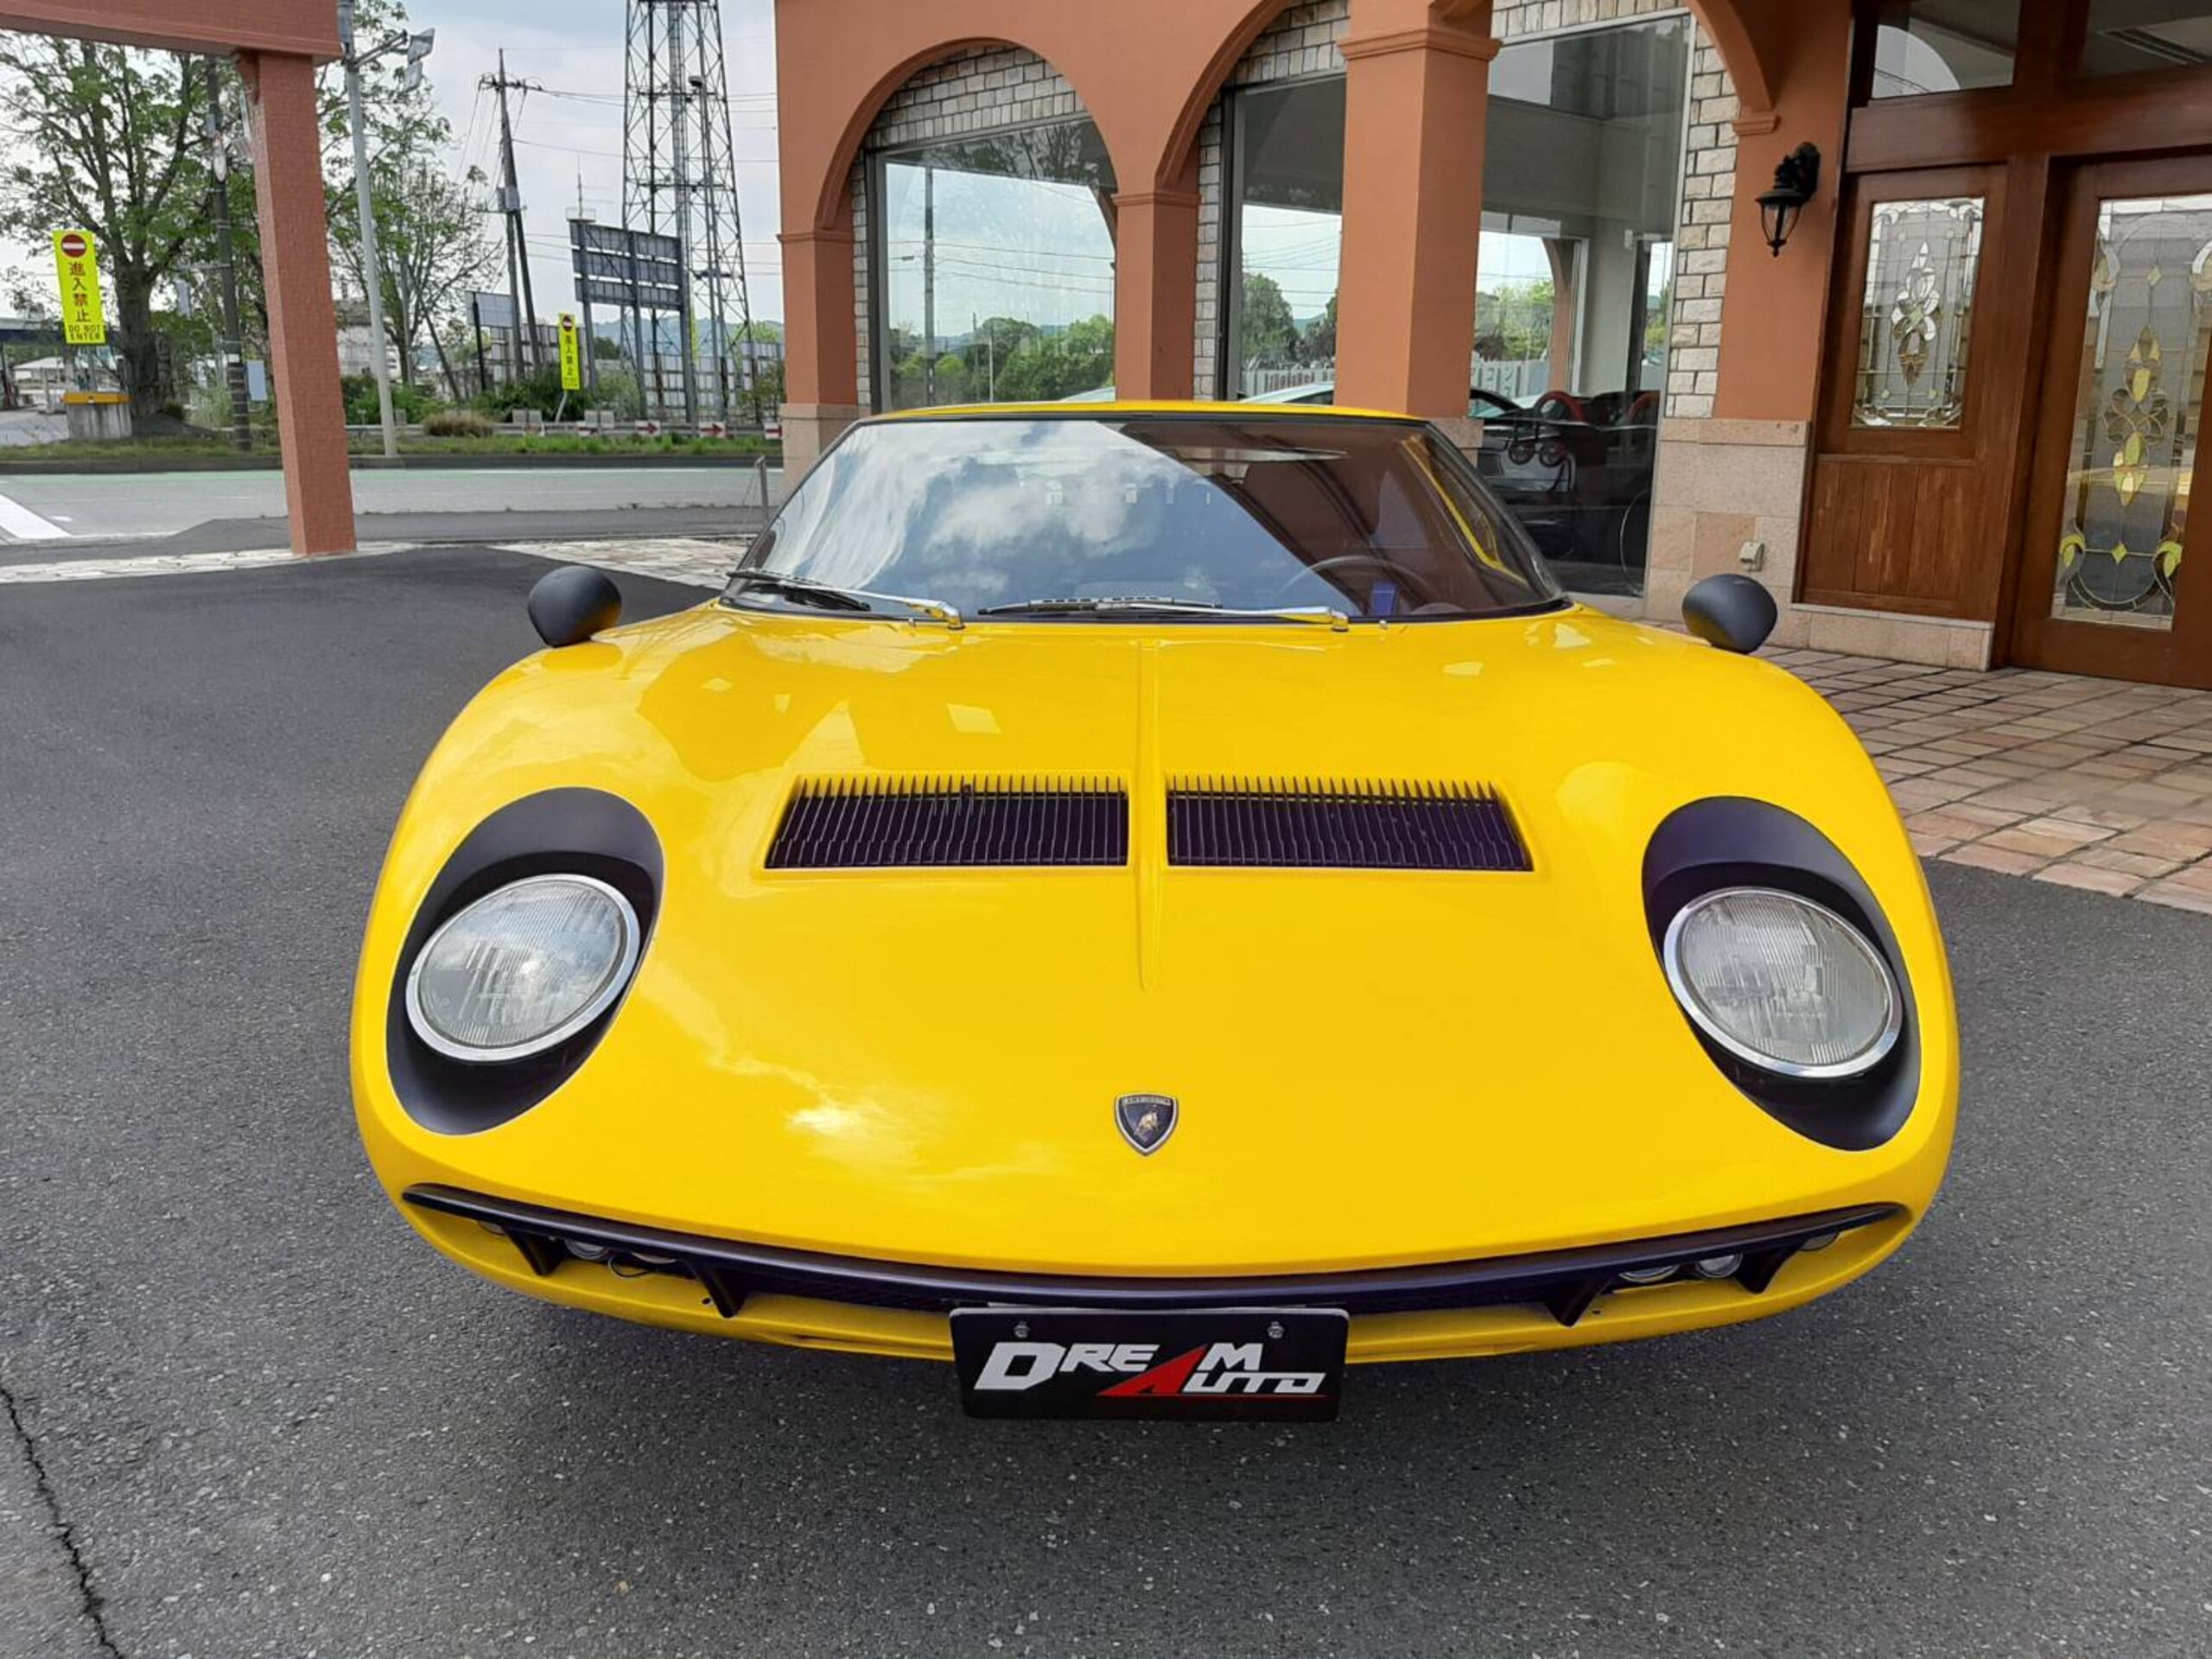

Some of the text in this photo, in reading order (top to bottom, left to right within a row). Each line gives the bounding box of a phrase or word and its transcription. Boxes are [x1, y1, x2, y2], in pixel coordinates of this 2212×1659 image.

[69, 262, 91, 322] 進入禁止
[68, 324, 101, 333] DO NOT
[70, 333, 101, 341] ENTER
